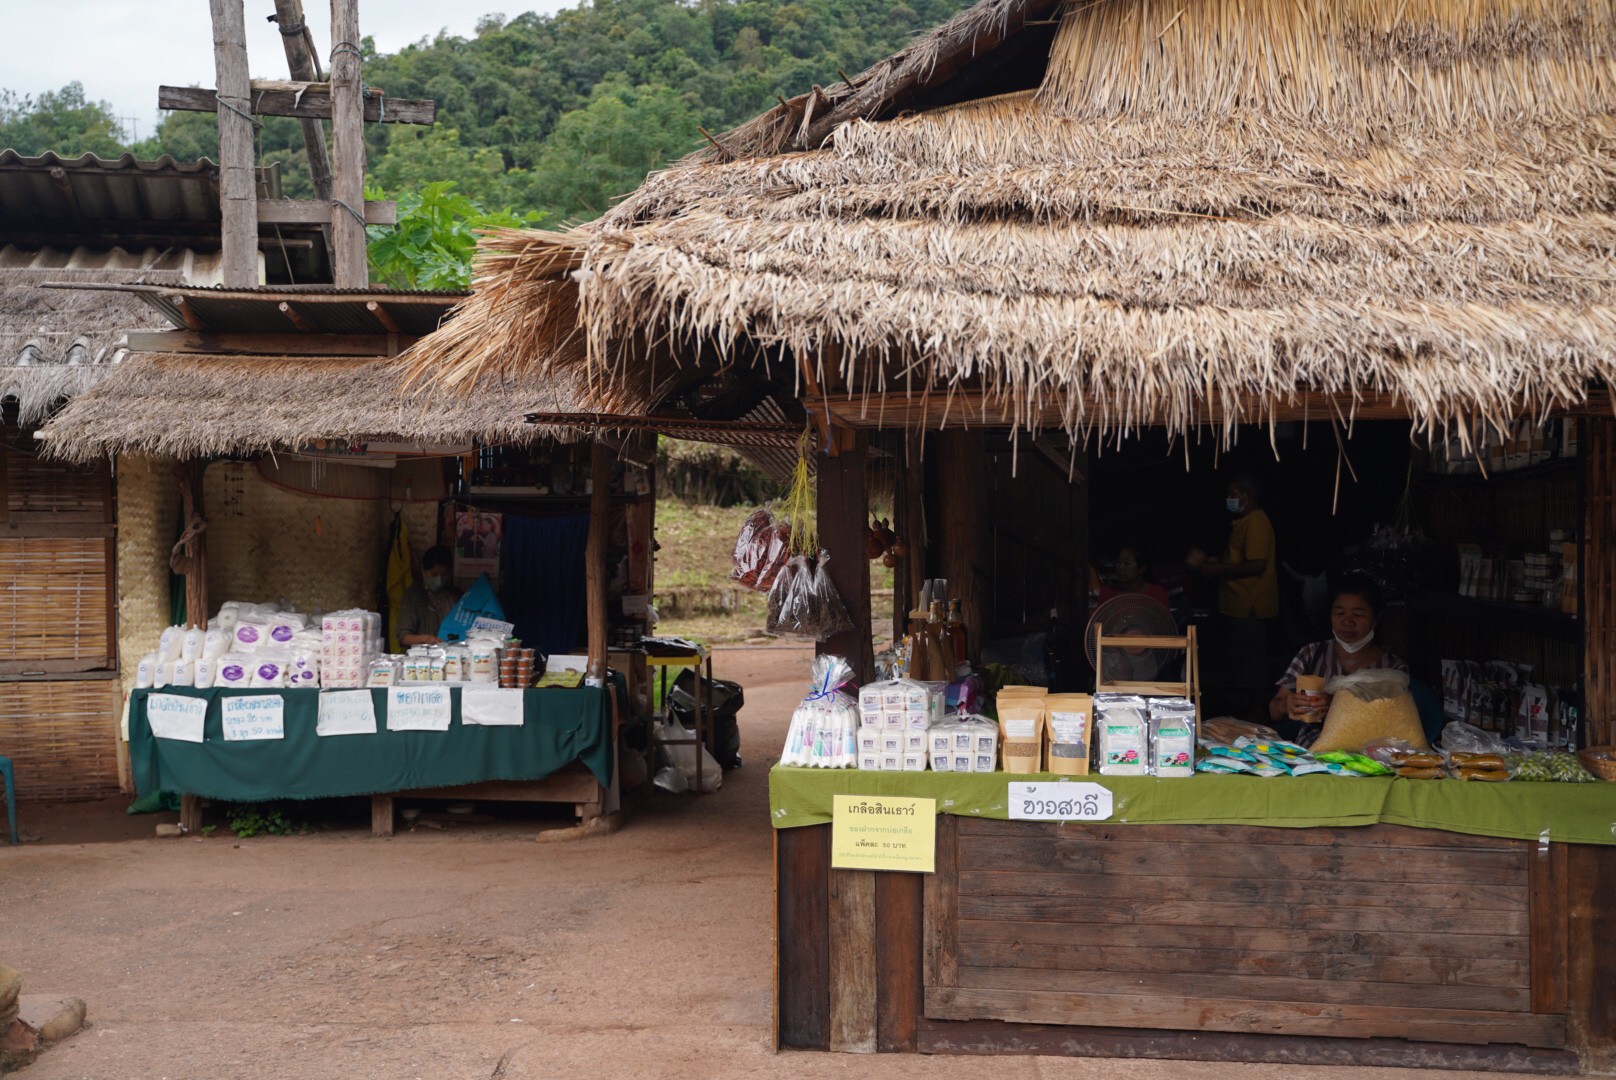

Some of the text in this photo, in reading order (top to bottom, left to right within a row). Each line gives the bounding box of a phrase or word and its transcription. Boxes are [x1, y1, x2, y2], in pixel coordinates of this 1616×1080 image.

[848, 801, 916, 816] เกลือสินเธาว์
[1023, 786, 1099, 816] ข้าวสาลี
